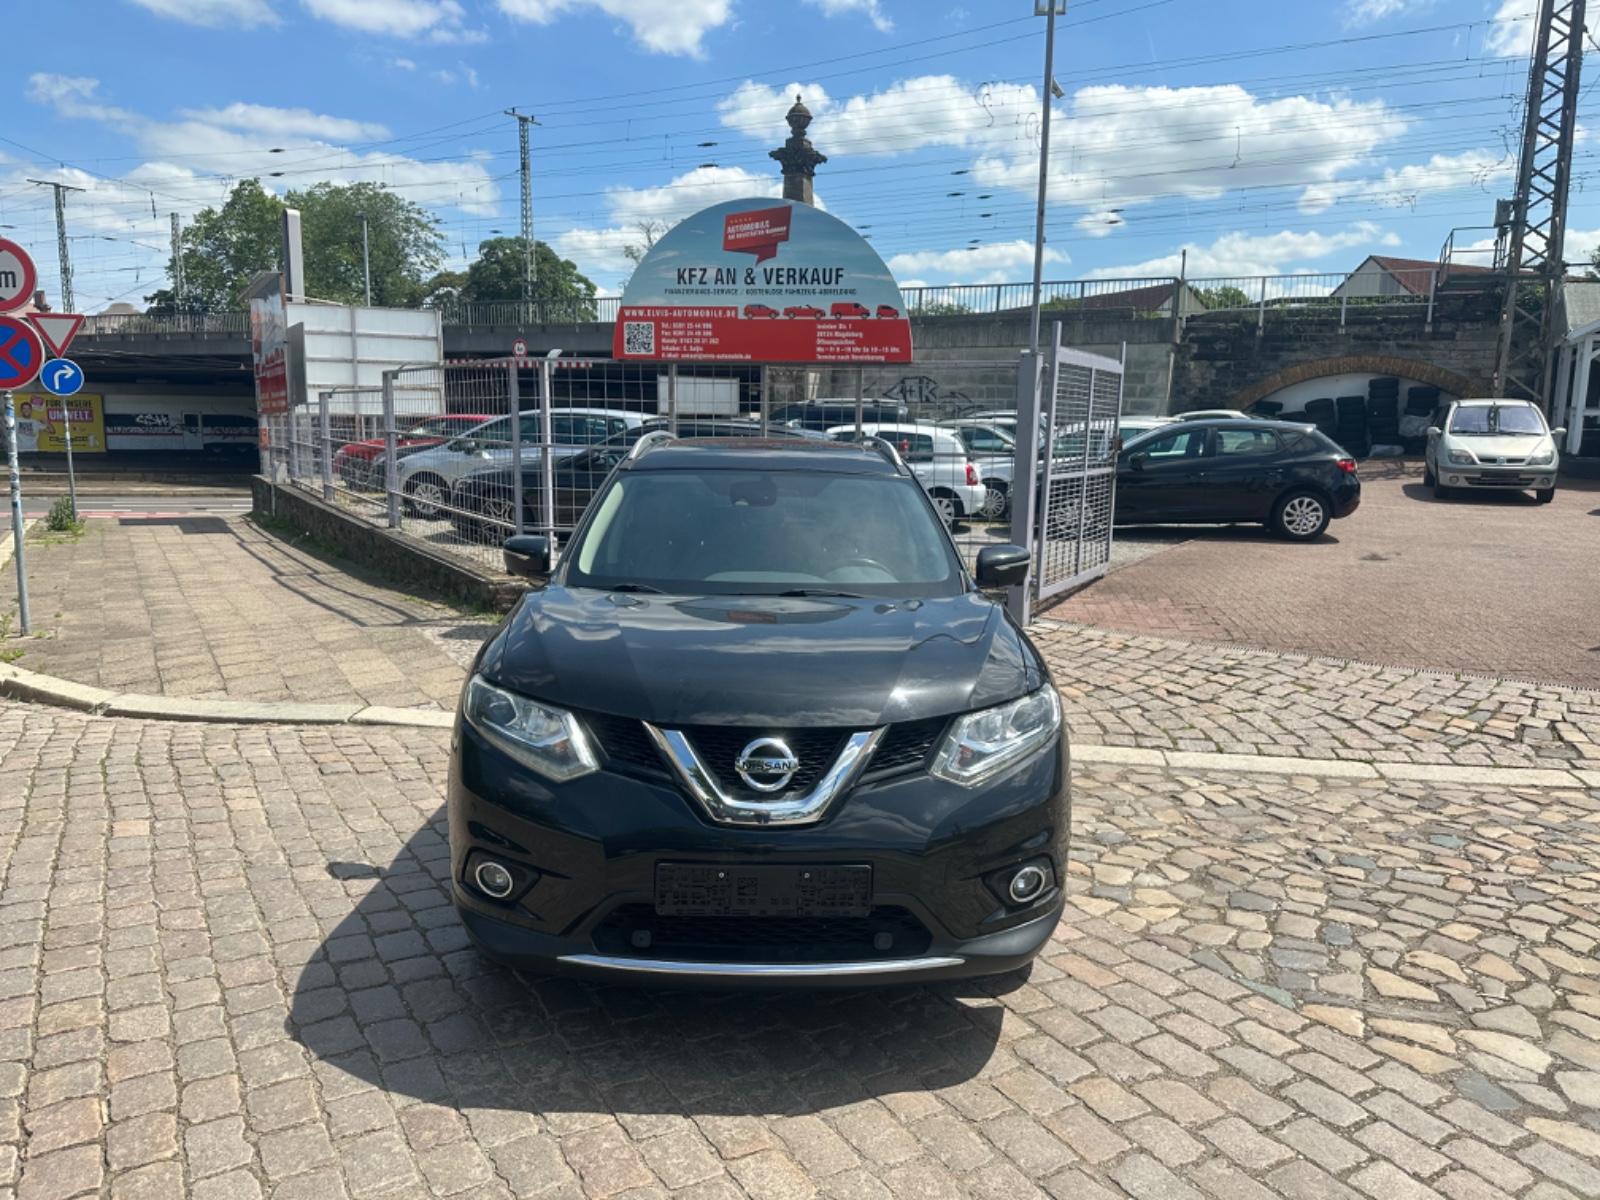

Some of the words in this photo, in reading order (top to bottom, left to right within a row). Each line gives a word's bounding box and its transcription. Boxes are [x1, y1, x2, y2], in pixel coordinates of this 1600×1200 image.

[677, 268, 708, 285] KFZ
[714, 268, 737, 285] AN
[743, 267, 756, 285] &
[763, 267, 845, 285] VERKAUF
[742, 761, 792, 770] NISSAN
